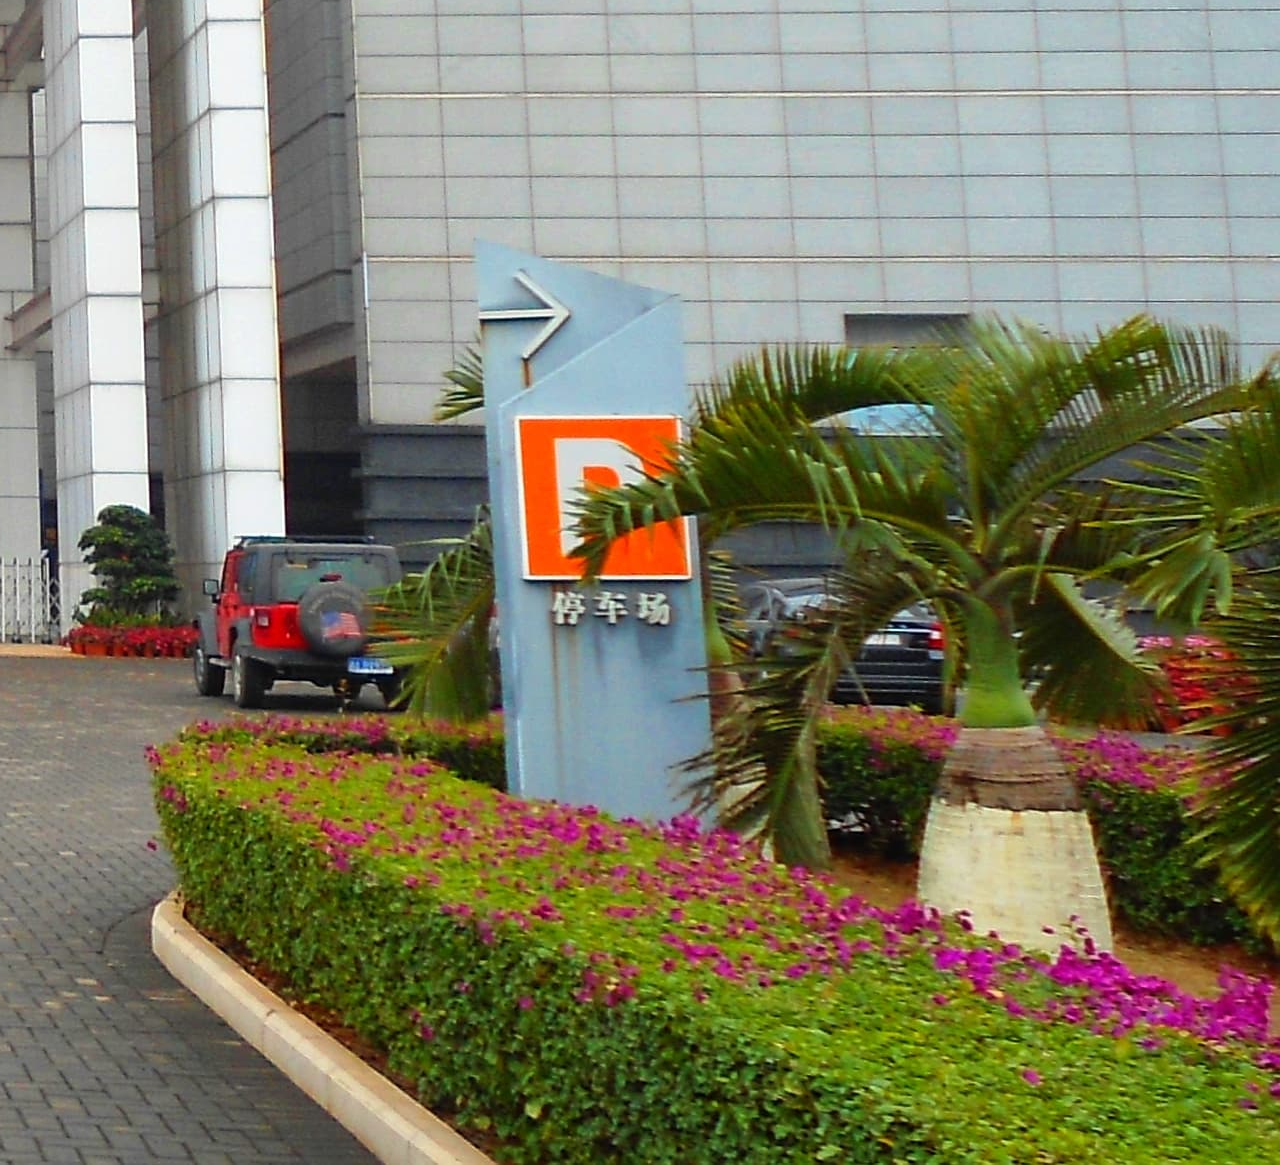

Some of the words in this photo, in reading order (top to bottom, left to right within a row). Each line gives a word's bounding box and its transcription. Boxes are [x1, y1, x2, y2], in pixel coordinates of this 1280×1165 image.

[553, 437, 647, 557] P
[551, 592, 672, 626] 停车场
